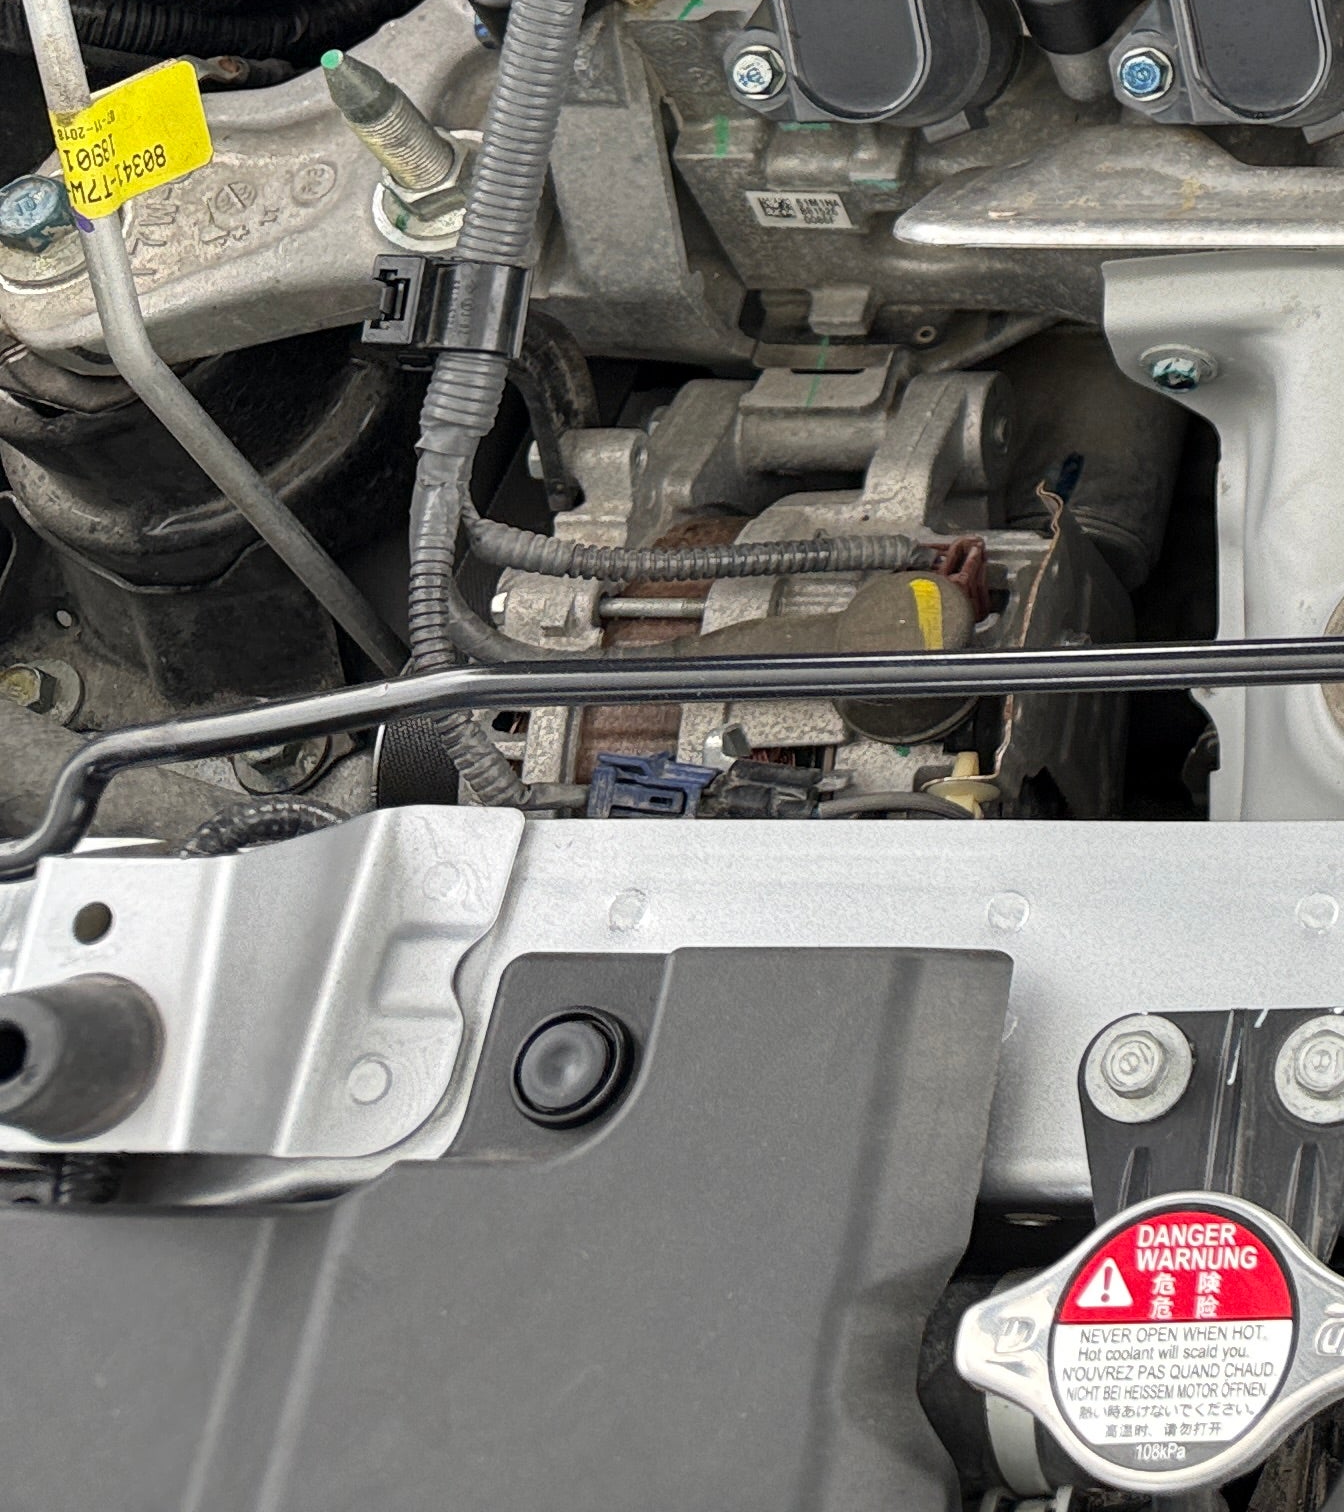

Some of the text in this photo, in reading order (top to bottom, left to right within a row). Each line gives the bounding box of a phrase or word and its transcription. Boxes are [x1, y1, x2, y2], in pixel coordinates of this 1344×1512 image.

[1138, 1224, 1237, 1248] DANGER
[1136, 1246, 1259, 1271] WARNUNG
[1080, 1325, 1267, 1344] NEVER OPEN WHEN HOT.
[1078, 1347, 1101, 1361] Hot
[1105, 1346, 1154, 1360] coolant
[1158, 1345, 1179, 1359] will
[1221, 1347, 1250, 1362] you.
[1062, 1365, 1134, 1381] N'OUVREZ
[1138, 1364, 1166, 1379] PAS
[1169, 1363, 1221, 1380] QUAND
[1066, 1386, 1101, 1401] NICHT
[1102, 1385, 1123, 1400] BEI
[1123, 1384, 1175, 1400] HEISSEM
[1176, 1382, 1218, 1399] MOTOR
[1135, 1443, 1187, 1460] 108kPa
